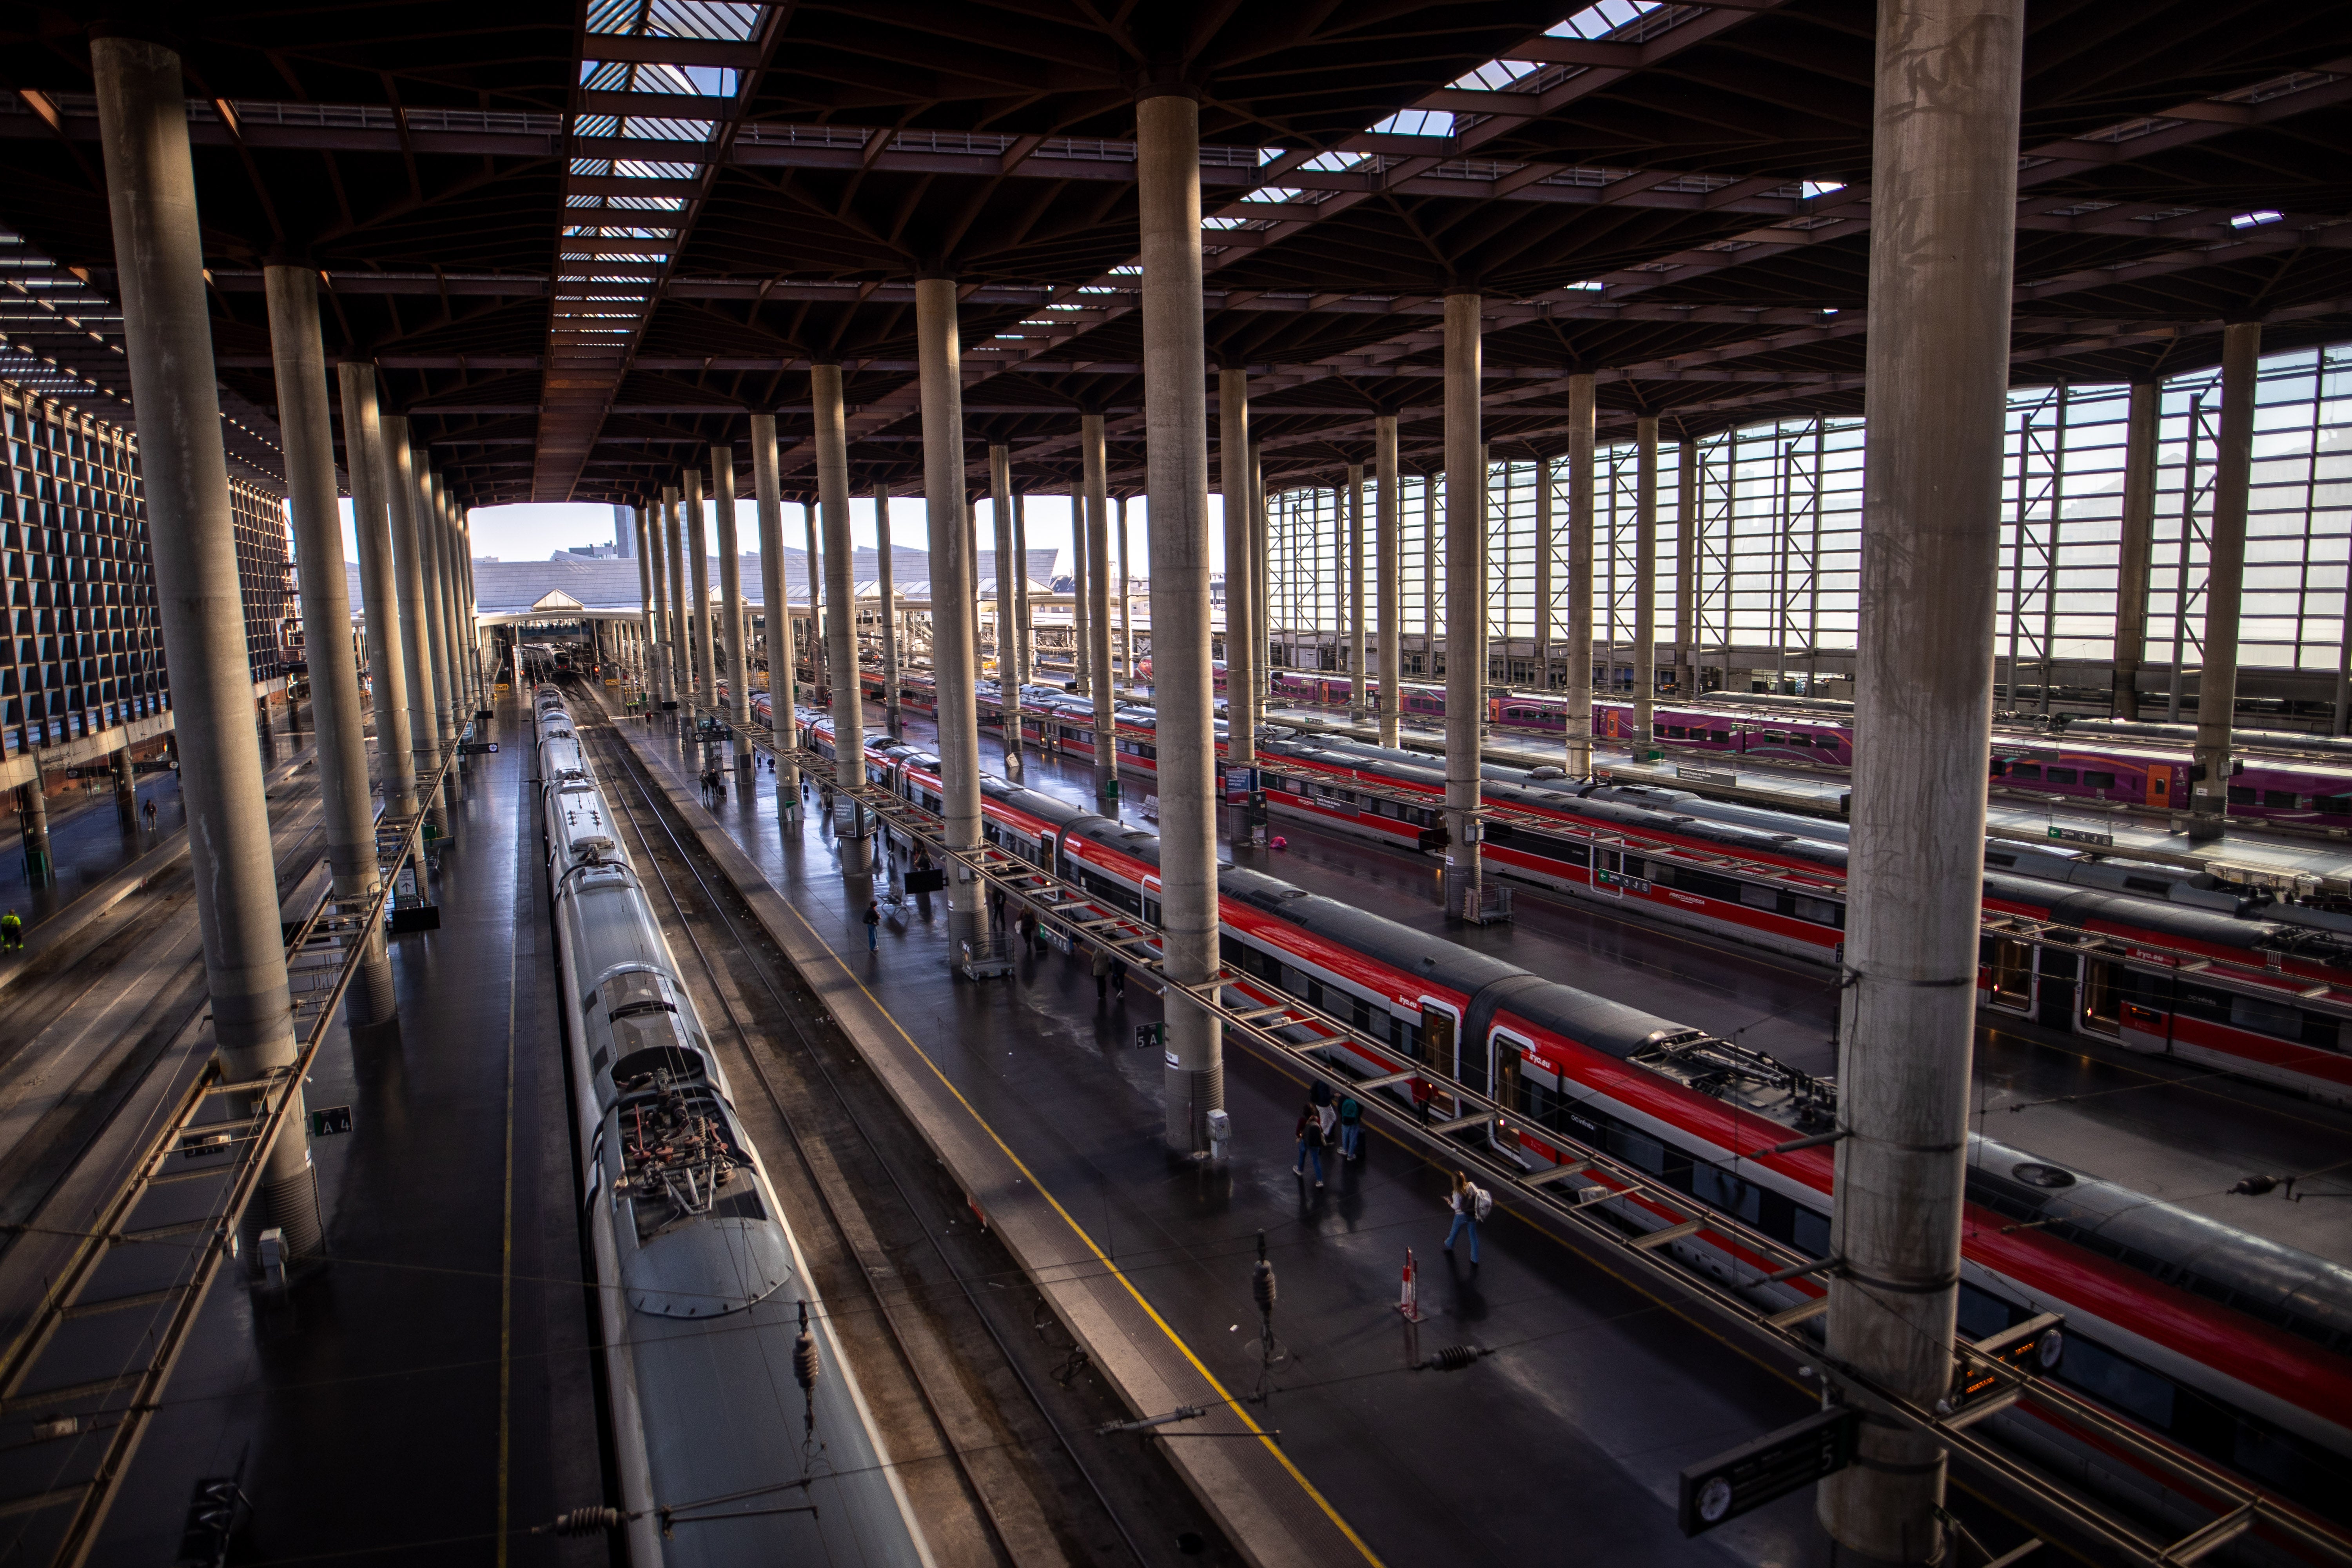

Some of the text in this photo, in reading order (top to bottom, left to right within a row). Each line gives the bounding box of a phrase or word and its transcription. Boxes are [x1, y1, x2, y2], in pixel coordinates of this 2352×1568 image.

[1669, 892, 1705, 905] FRECCIAROSSA
[1837, 953, 1842, 962] 7
[2136, 949, 2163, 961] iryo.eu
[1399, 994, 1417, 1009] iryo.eu
[1138, 1034, 1157, 1047] 5 A
[1529, 1051, 1551, 1069] iryo.eu
[323, 1118, 350, 1134] A 4
[1821, 1443, 1834, 1471] 5
